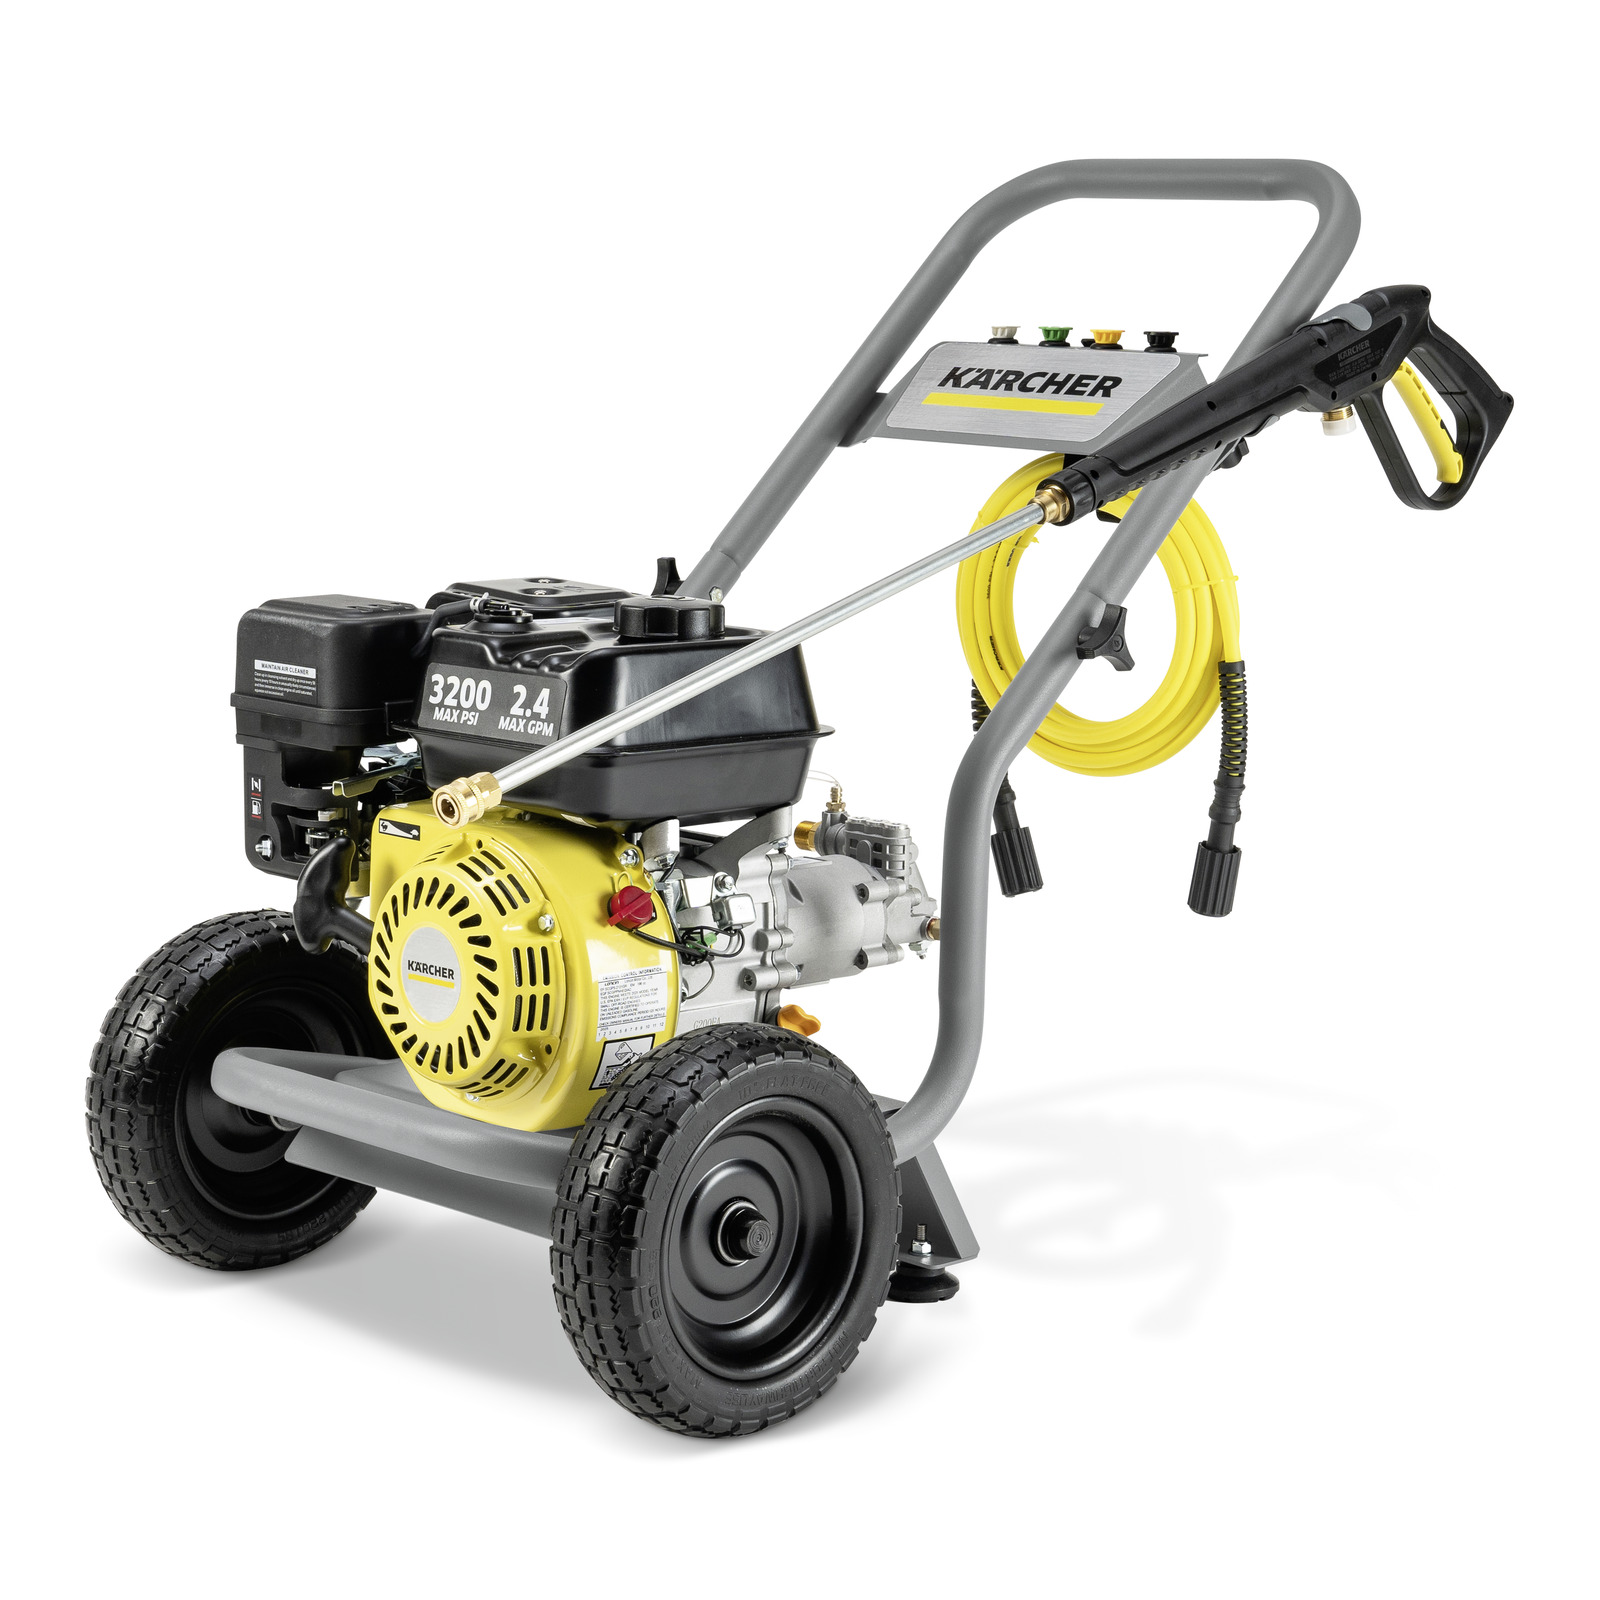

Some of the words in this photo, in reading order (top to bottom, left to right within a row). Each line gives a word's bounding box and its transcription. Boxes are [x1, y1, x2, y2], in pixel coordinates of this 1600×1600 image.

[937, 366, 1122, 397] KÄRCHER
[428, 673, 492, 711] 3200
[509, 684, 550, 719] 2.4
[433, 706, 460, 723] MAX
[460, 711, 479, 726] PSI
[498, 715, 527, 732] MAX
[527, 720, 554, 736] GPM
[407, 960, 455, 980] KÄRCHER
